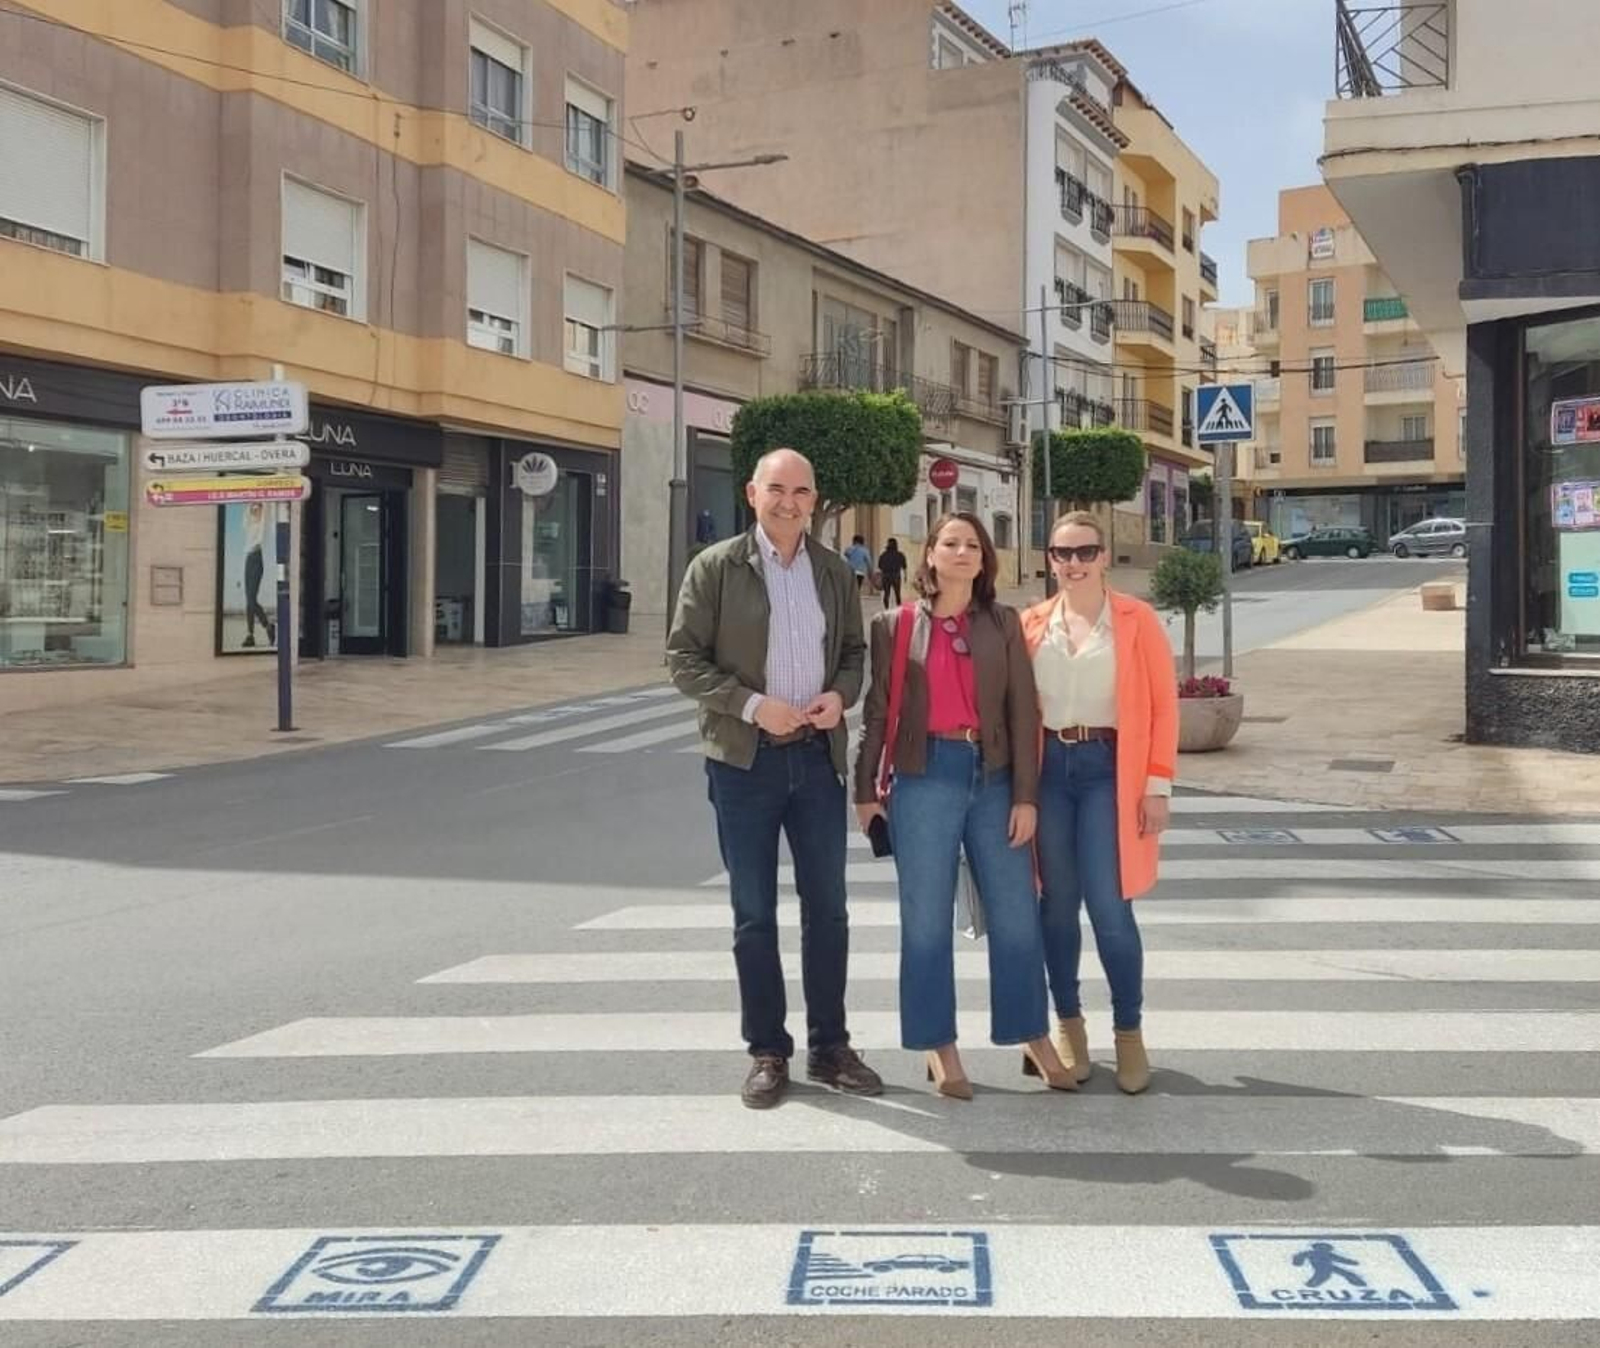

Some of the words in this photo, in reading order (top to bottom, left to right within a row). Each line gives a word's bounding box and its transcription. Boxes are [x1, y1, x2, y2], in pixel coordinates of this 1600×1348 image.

[167, 453, 195, 464] BAZA
[203, 451, 251, 463] HUERCAL
[261, 449, 296, 460] OVERA
[330, 462, 373, 479] LUNA
[303, 1290, 410, 1303] MIRA
[811, 1285, 879, 1298] COCHE
[886, 1286, 967, 1298] PARADO
[1271, 1289, 1412, 1301] CRUZA
